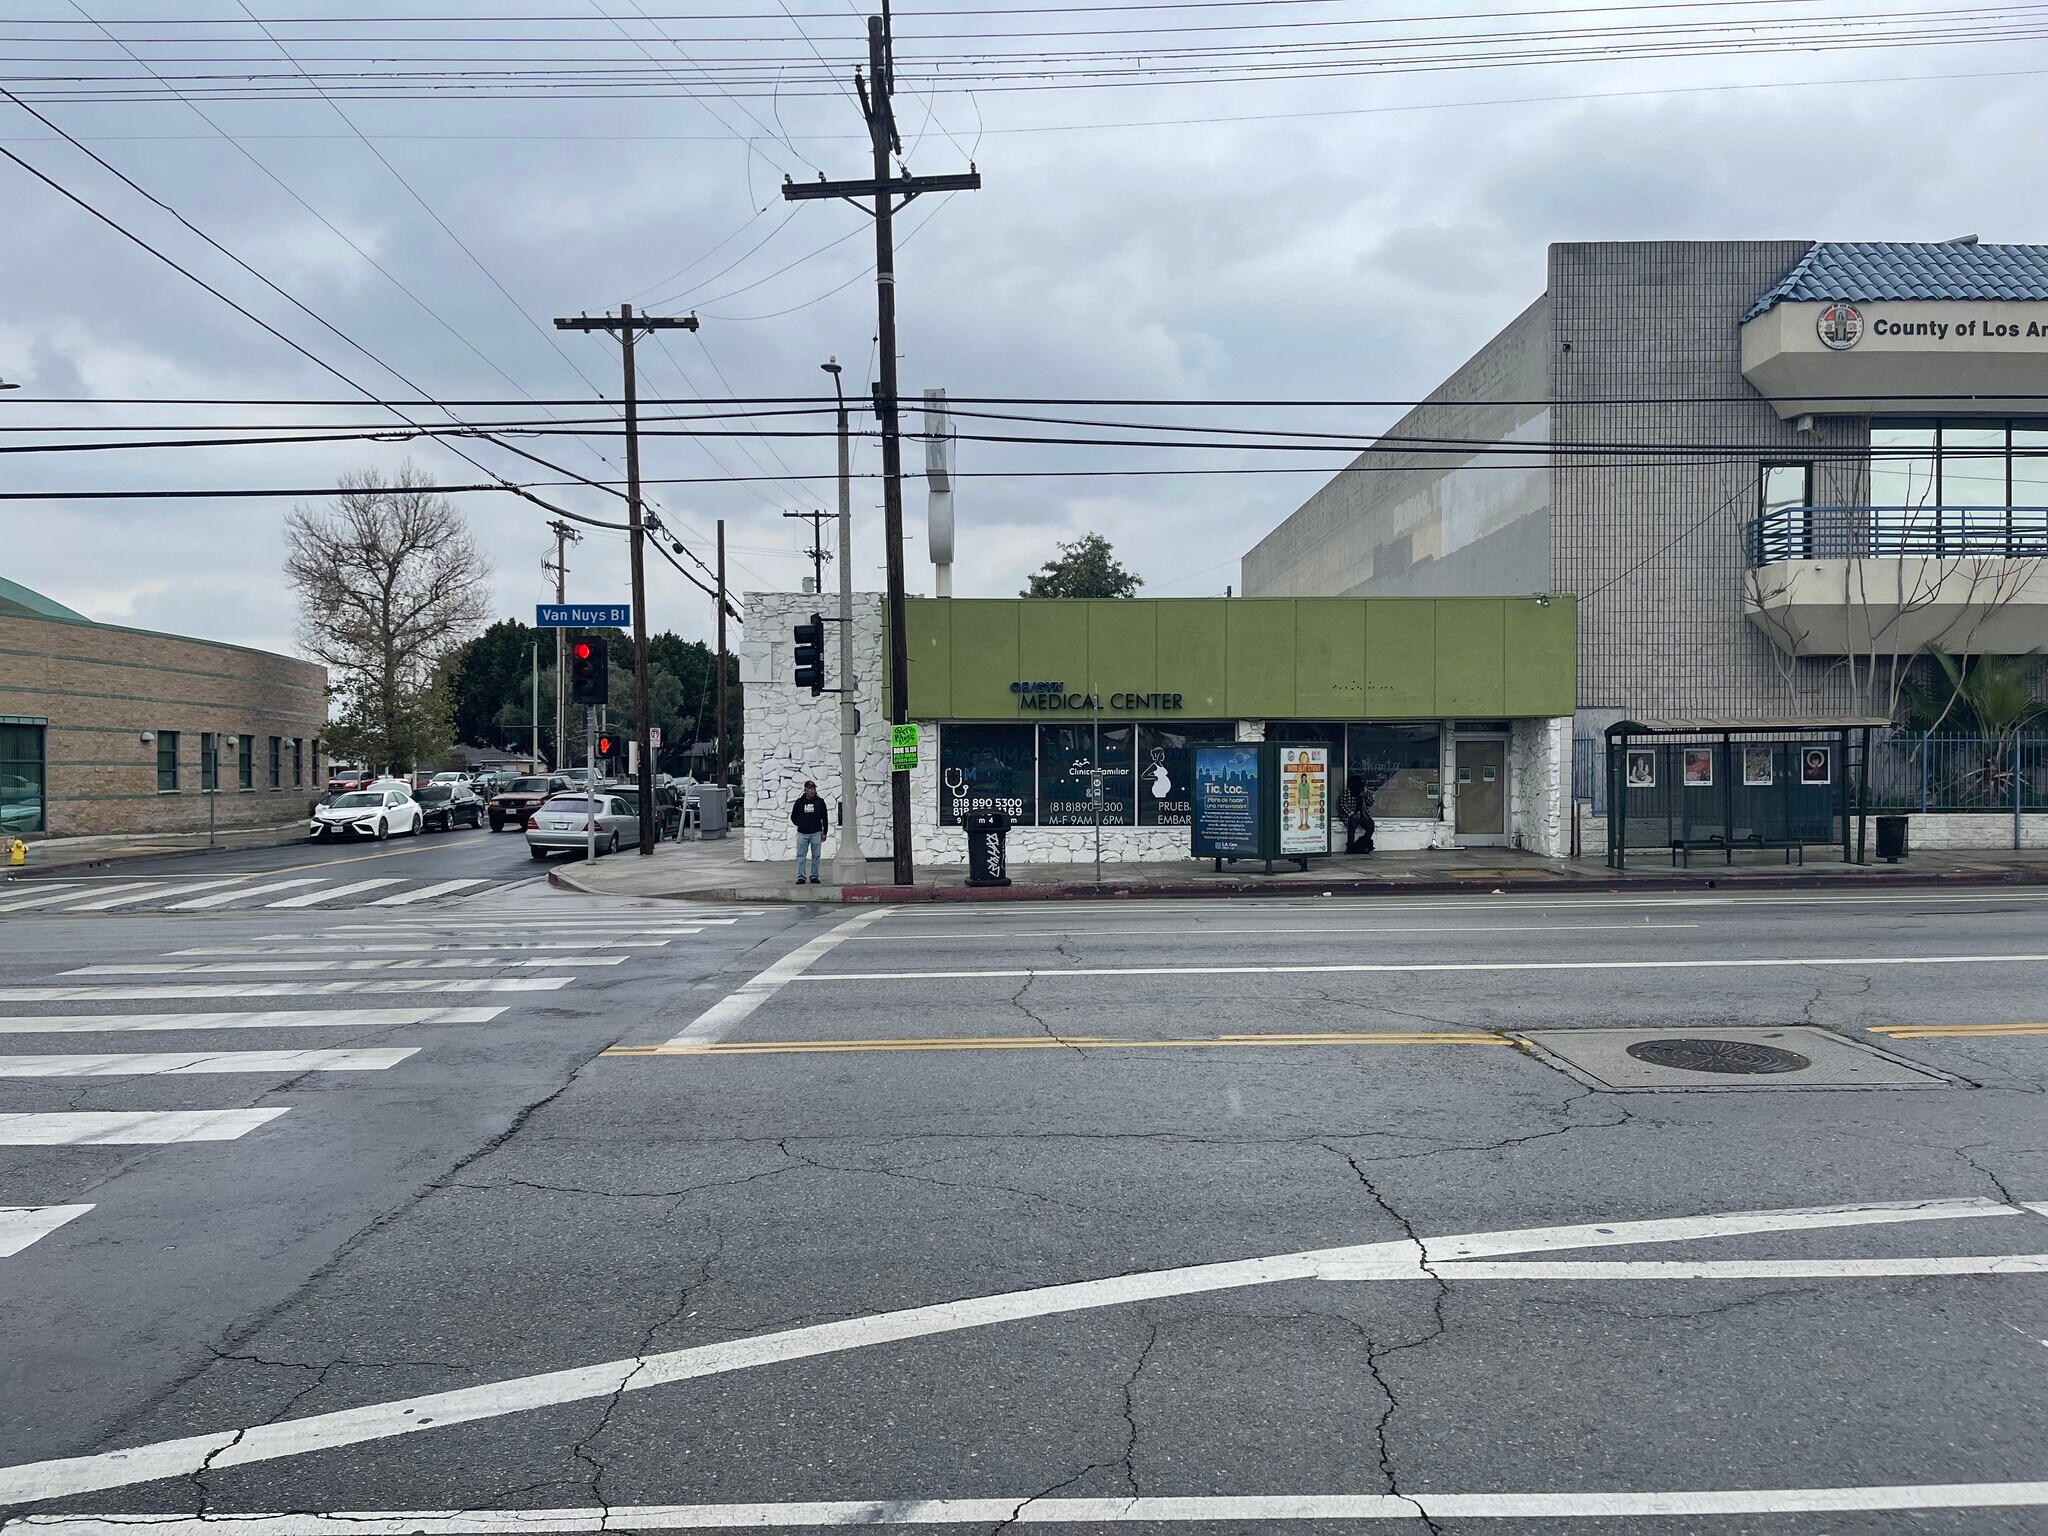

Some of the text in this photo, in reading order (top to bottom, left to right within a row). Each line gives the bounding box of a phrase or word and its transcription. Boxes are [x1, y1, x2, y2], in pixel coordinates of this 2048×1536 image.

[1873, 318, 1949, 340] County
[1955, 320, 1976, 336] of
[1983, 320, 2020, 337] Los
[542, 609, 624, 624] Van Nuys Bl
[1010, 681, 1064, 693] OB/GYN
[1020, 693, 1183, 710] MEDICAL CENTER
[1204, 782, 1222, 795] Tic,
[952, 798, 1023, 808] 818 890 5300
[1158, 801, 1192, 811] PRUEB
[1048, 815, 1124, 825] M-F 9AM 6PM
[1157, 815, 1192, 825] EMBAR
